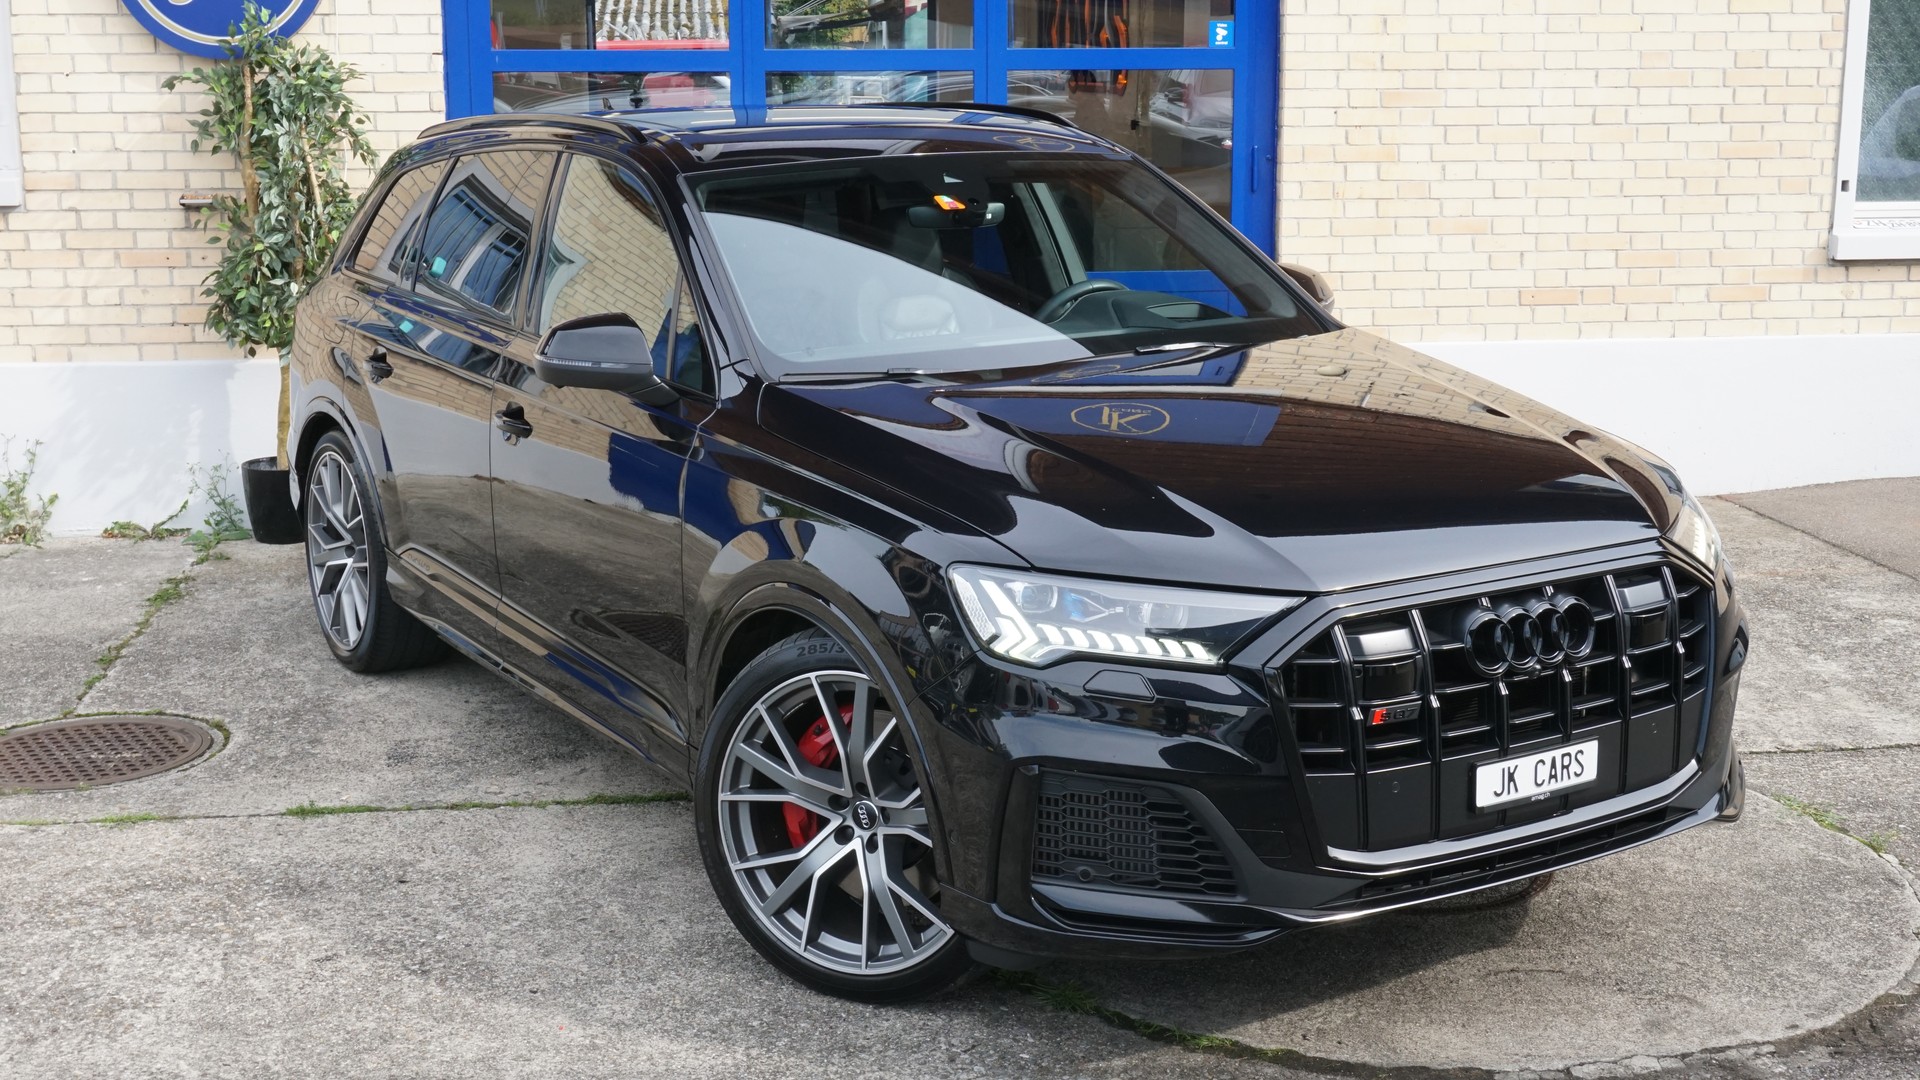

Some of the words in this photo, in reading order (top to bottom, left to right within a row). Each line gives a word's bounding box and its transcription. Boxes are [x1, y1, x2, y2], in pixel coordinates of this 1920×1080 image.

[796, 642, 848, 657] 285/3
[1493, 764, 1519, 798] JK
[1534, 749, 1585, 788] CARS
